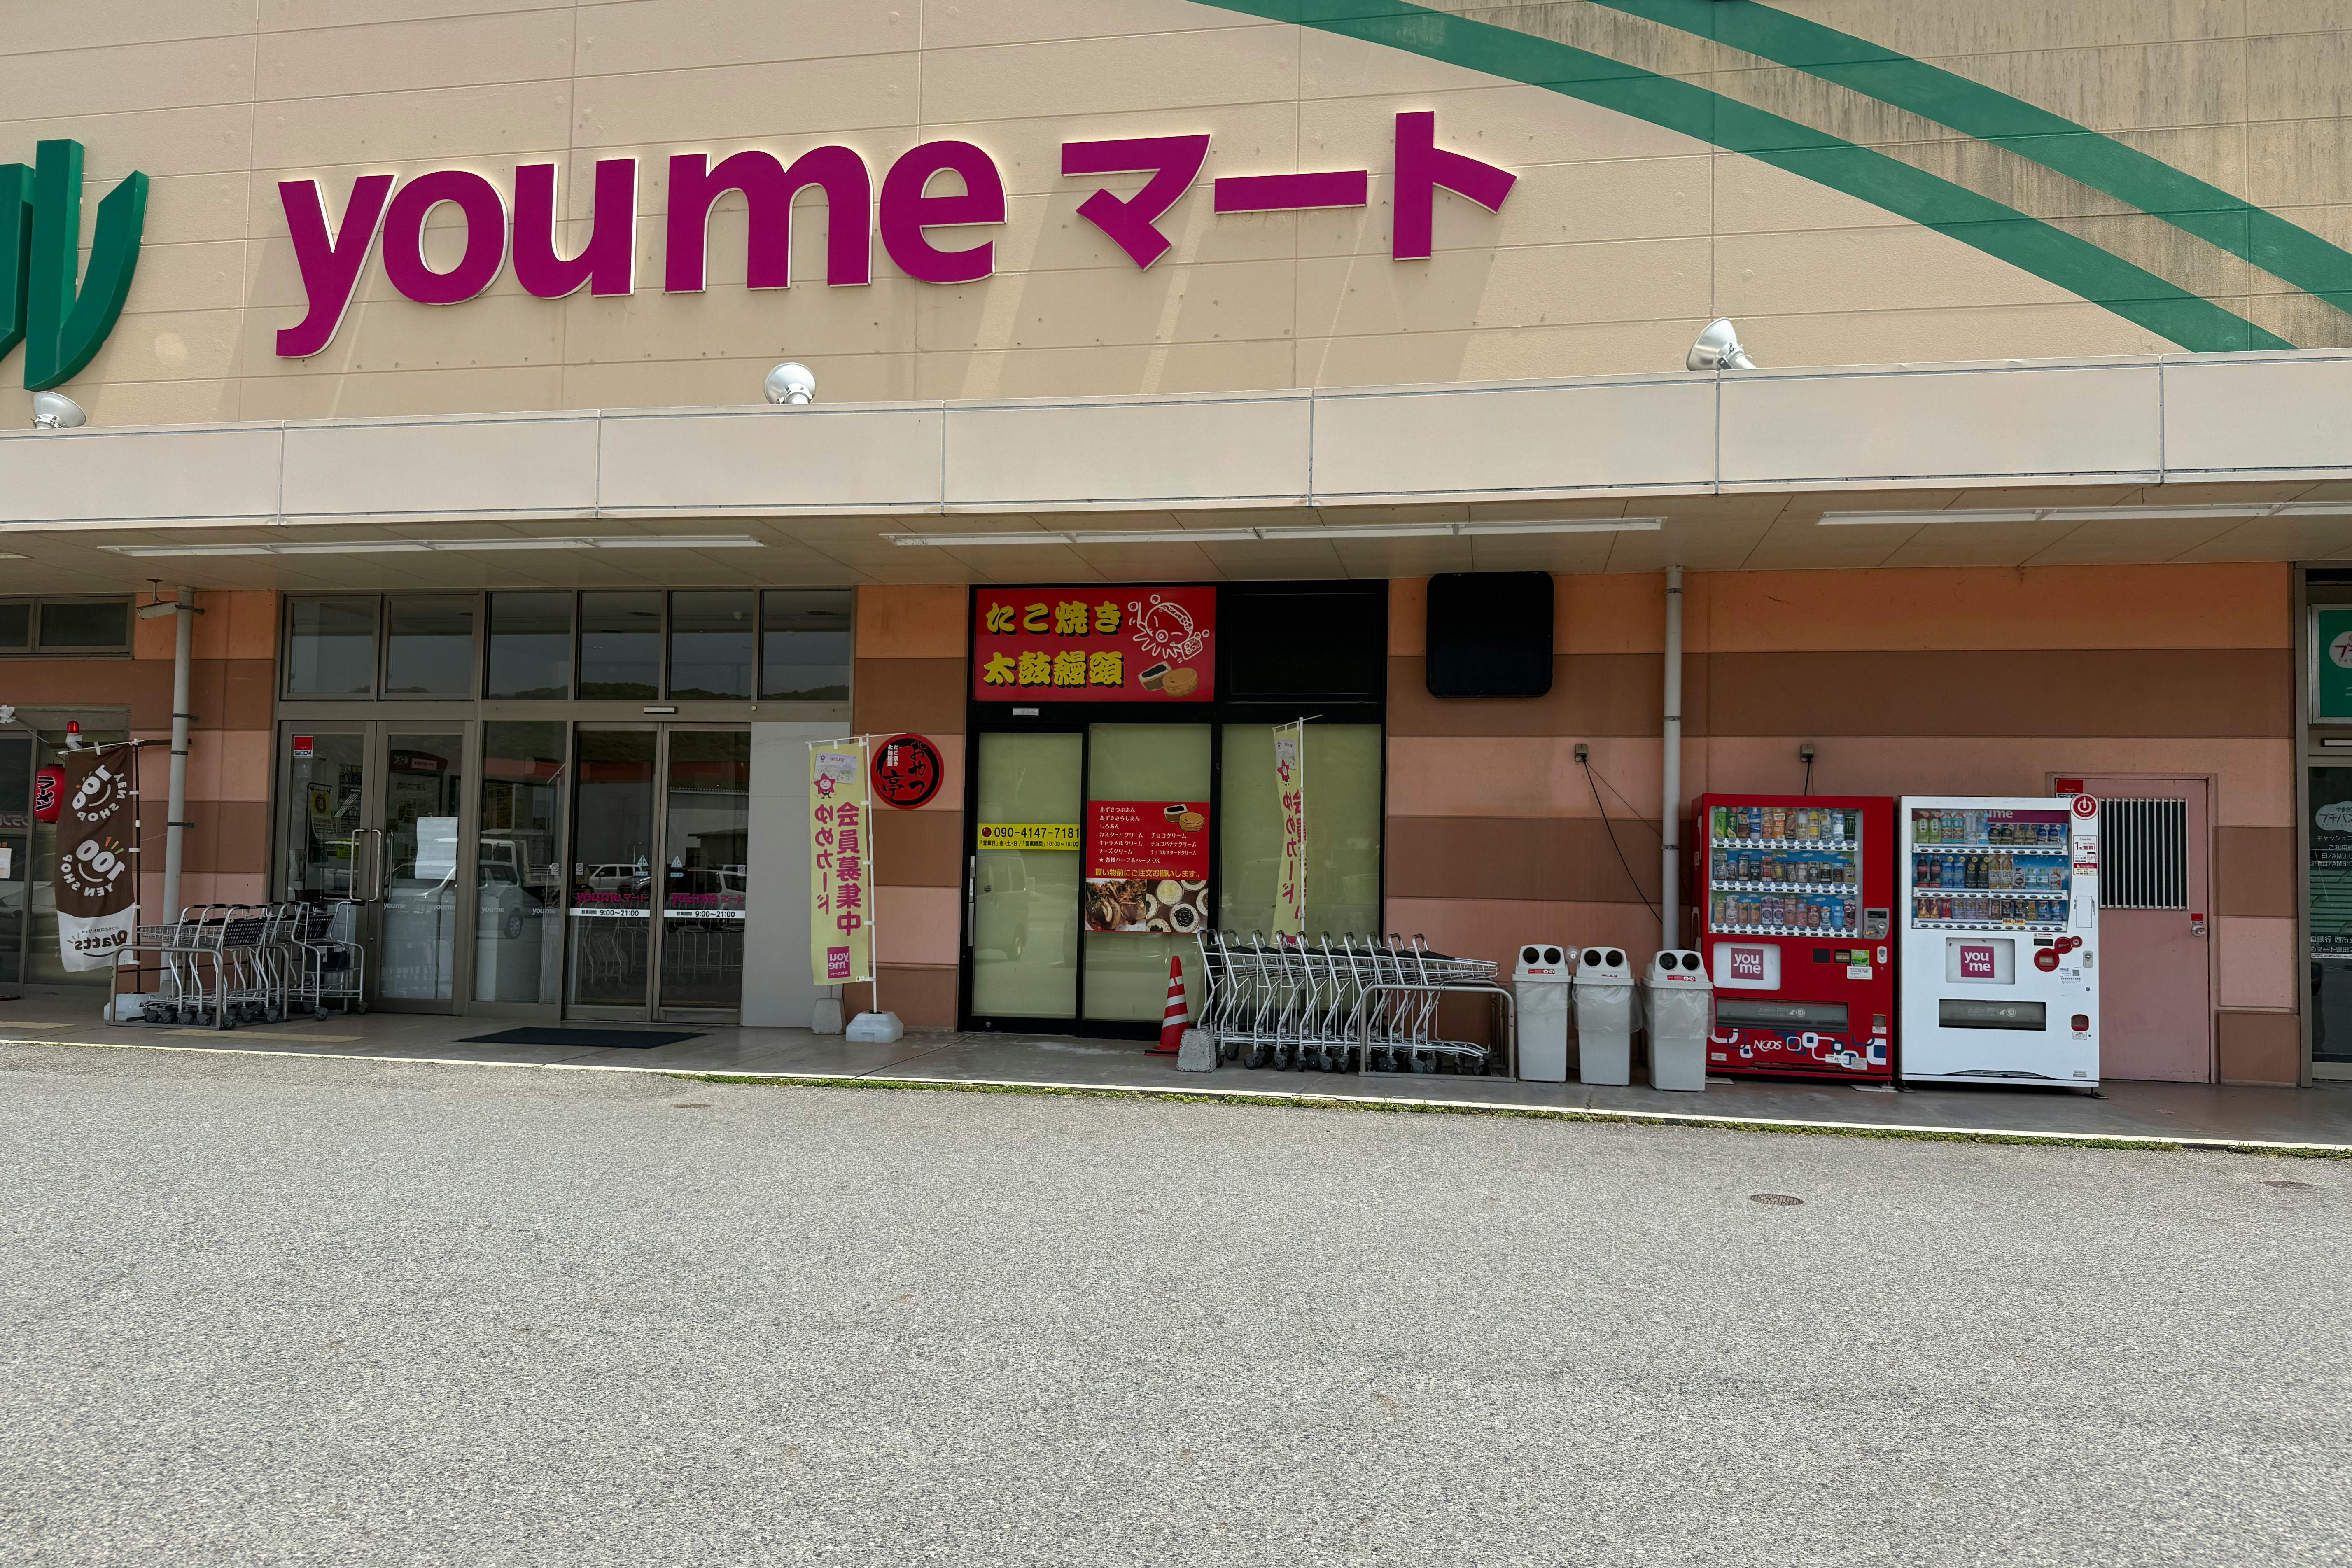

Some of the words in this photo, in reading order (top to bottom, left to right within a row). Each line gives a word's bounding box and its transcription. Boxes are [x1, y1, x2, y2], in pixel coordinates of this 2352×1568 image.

[277, 140, 1008, 358] youme
[1062, 111, 1517, 271] マート
[986, 600, 1123, 635] たこ焼き
[983, 651, 1124, 687] 太鼓饅頭
[994, 827, 1079, 838] 090-4147-7181
[576, 892, 622, 905] youme
[1733, 954, 1759, 966] you
[1964, 952, 1989, 963] you
[1740, 963, 1761, 974] me
[1969, 962, 1991, 972] me
